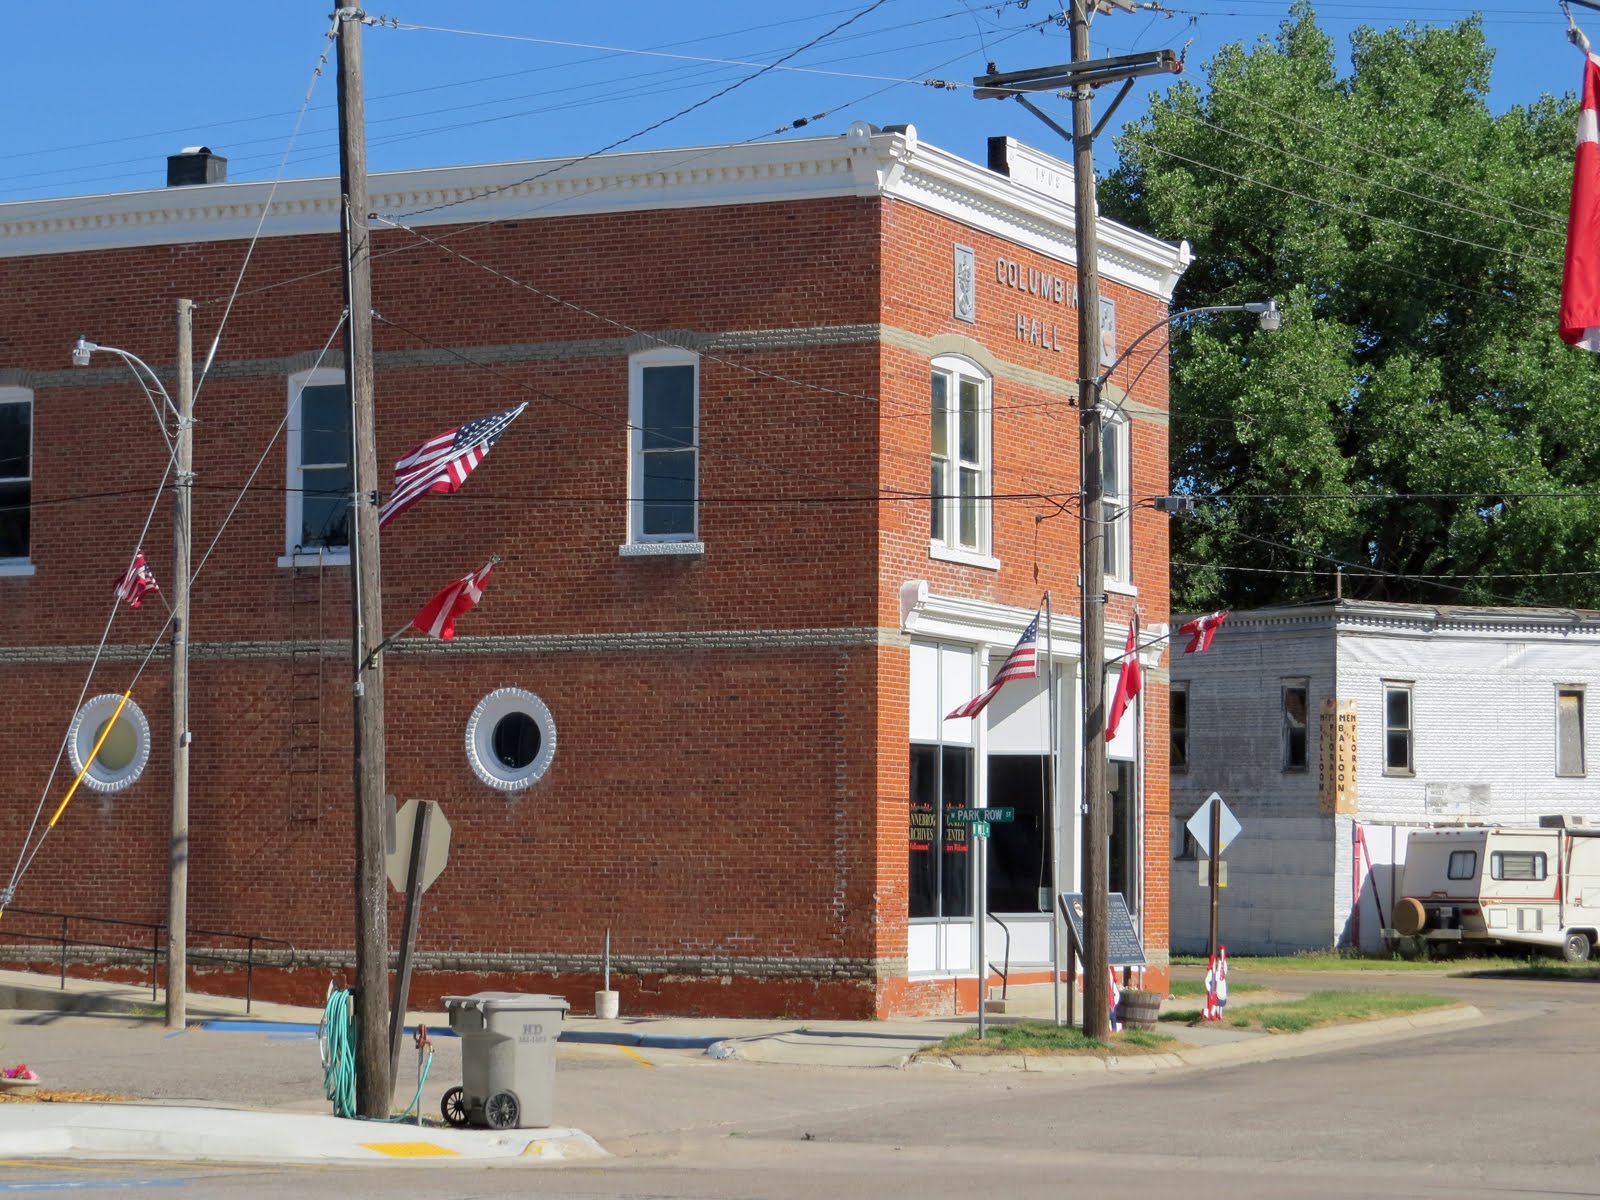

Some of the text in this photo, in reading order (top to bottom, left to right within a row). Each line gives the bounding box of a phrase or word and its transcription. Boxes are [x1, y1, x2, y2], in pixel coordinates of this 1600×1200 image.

[1016, 313, 1062, 352] HALL
[958, 810, 979, 820] PARK
[984, 810, 1002, 820] ROW
[909, 828, 934, 840] RCHIVES
